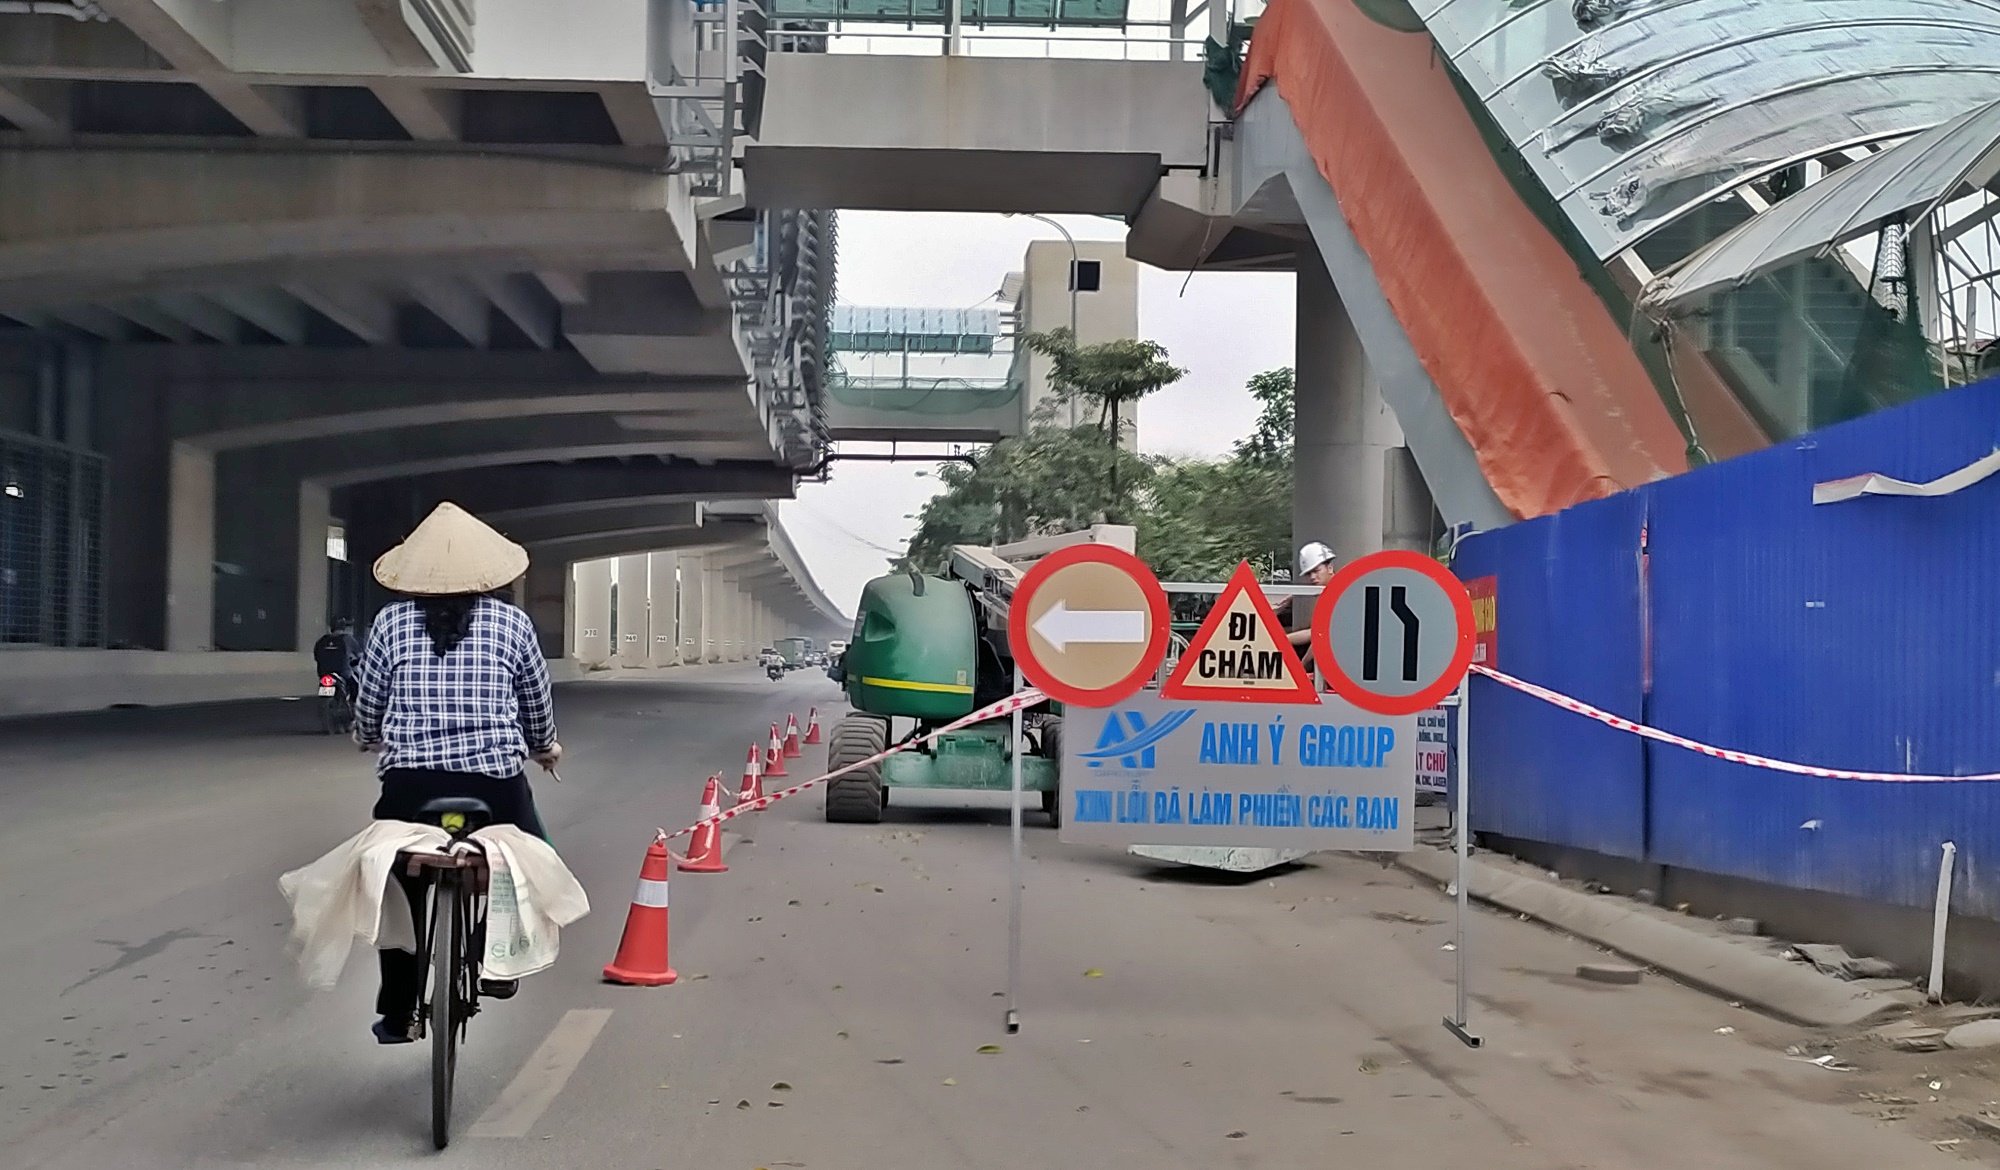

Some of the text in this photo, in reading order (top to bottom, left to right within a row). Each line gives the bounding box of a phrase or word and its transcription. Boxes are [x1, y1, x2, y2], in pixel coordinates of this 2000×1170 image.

[1228, 612, 1256, 641] ĐI
[1200, 714, 1395, 768] ANH Ý GROUP
[1426, 750, 1447, 773] CHỮ
[1075, 790, 1113, 822] XIN
[1154, 786, 1184, 824] ĐÃ
[1308, 789, 1349, 828] CÁC
